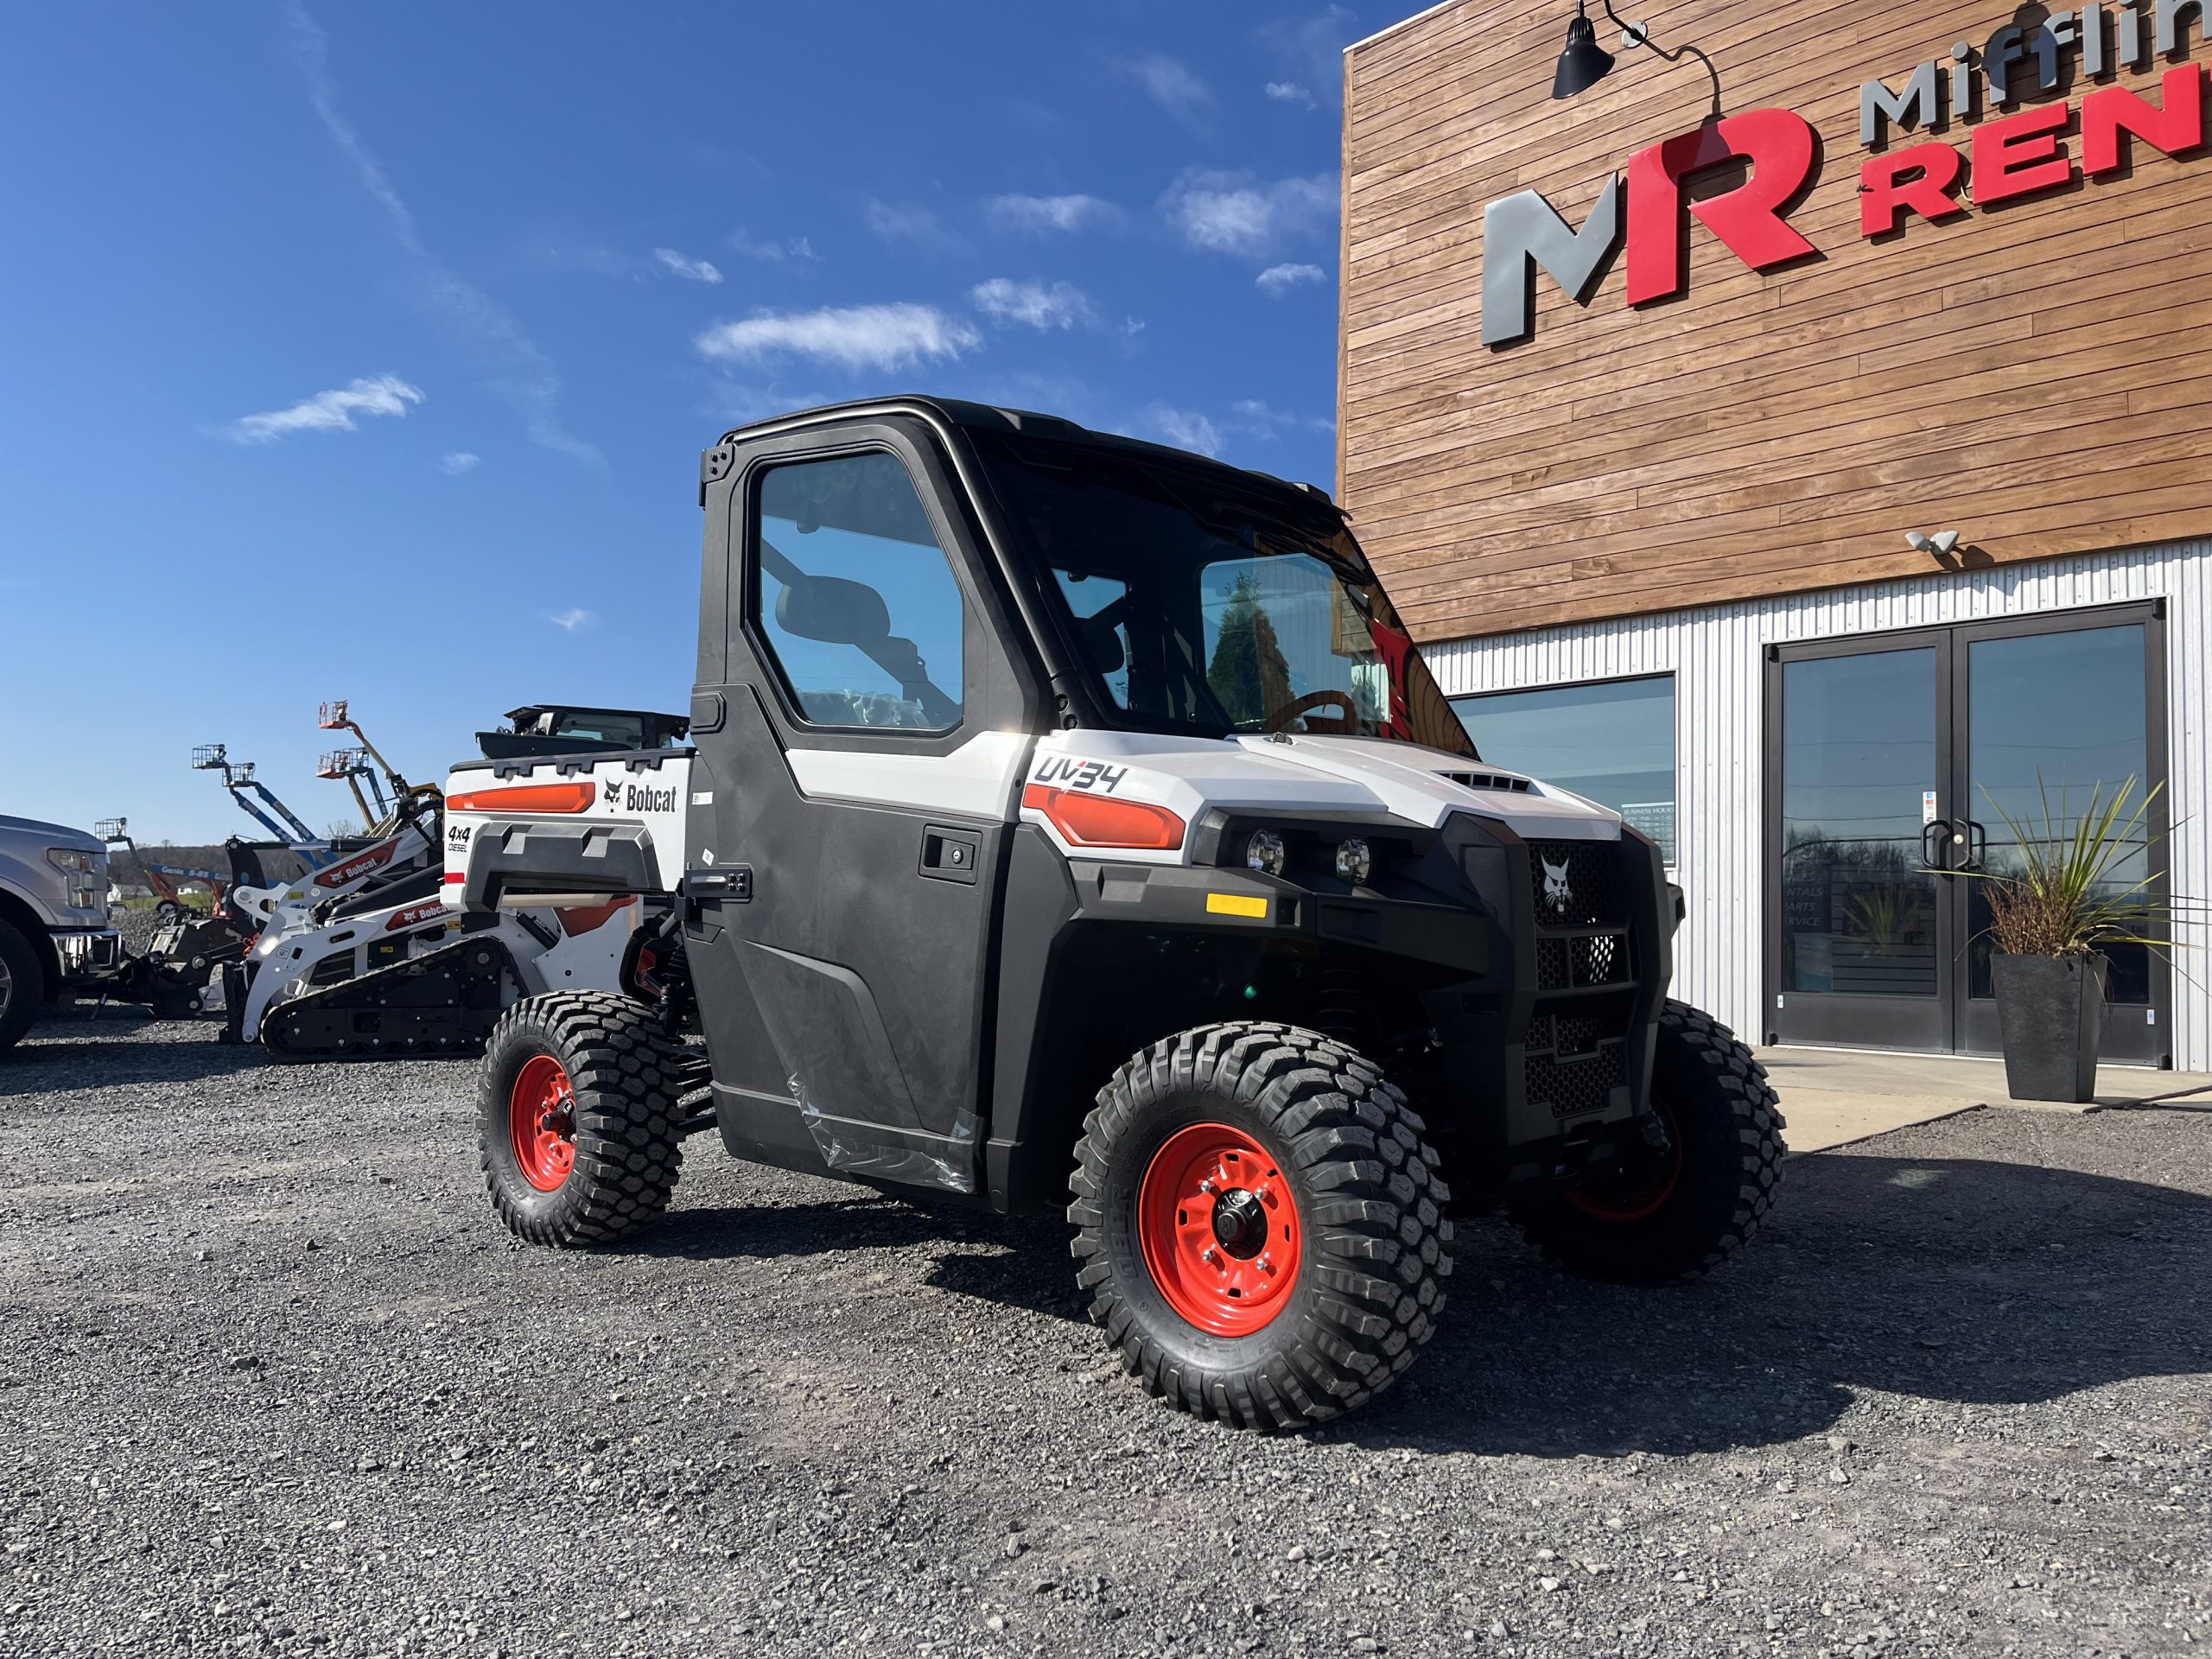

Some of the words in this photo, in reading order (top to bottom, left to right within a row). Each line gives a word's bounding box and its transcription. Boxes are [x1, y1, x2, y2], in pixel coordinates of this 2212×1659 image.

[1860, 0, 2212, 146] Mifflin
[1860, 58, 2212, 238] REN
[1481, 107, 1817, 346] MR
[1035, 757, 1128, 792] UV34
[626, 785, 677, 812] Bobcat
[448, 826, 471, 842] 4x4
[448, 843, 467, 852] DIESEL
[162, 866, 184, 875] Genie
[188, 869, 209, 878] S-85
[346, 857, 377, 878] Bobcat
[419, 906, 449, 918] Bobca
